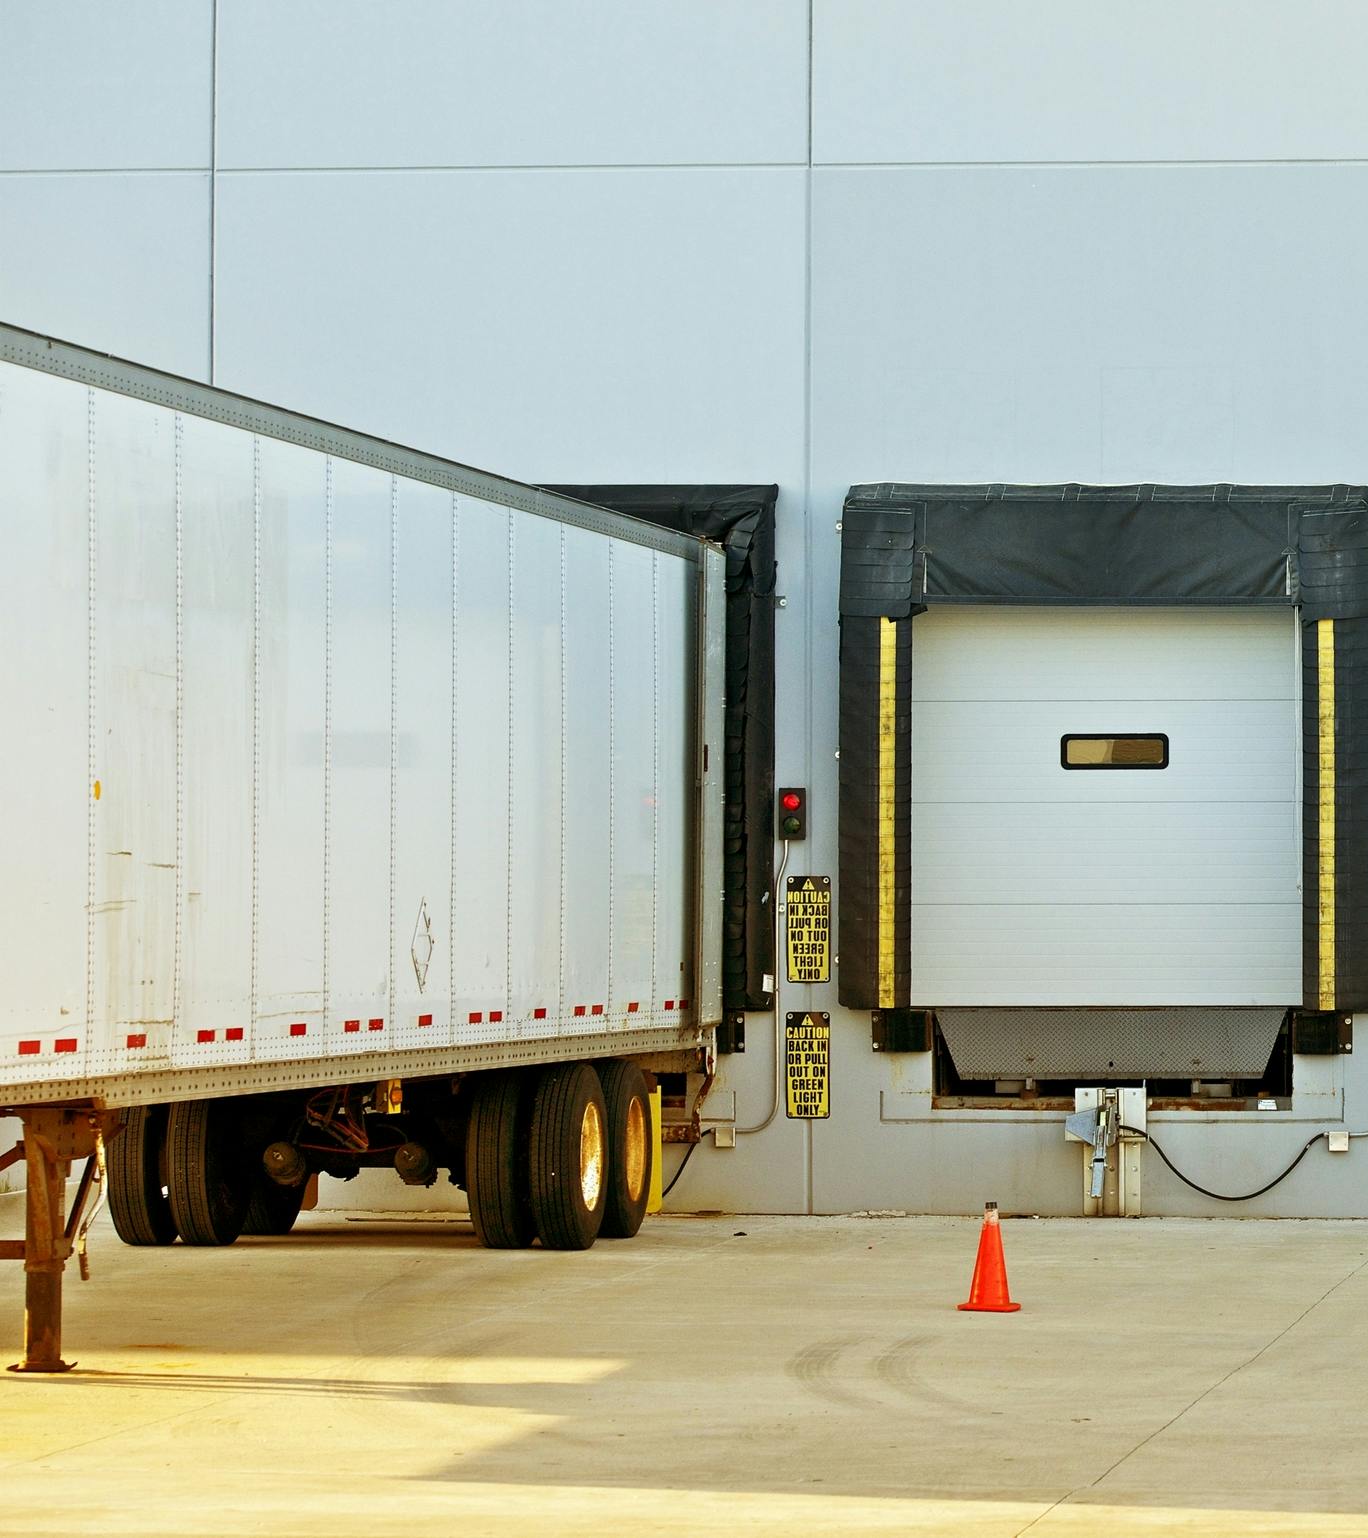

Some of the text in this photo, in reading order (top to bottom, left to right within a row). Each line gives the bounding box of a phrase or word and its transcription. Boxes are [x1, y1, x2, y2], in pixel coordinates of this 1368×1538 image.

[787, 1027, 829, 1038] CAUTION
[789, 1041, 826, 1051] BACK IN
[789, 1054, 827, 1064] OR PULL
[790, 1067, 825, 1077] OUT ON
[792, 1079, 823, 1089] GREEN
[794, 1092, 822, 1103] LIGHT
[797, 1104, 819, 1115] ONLY
